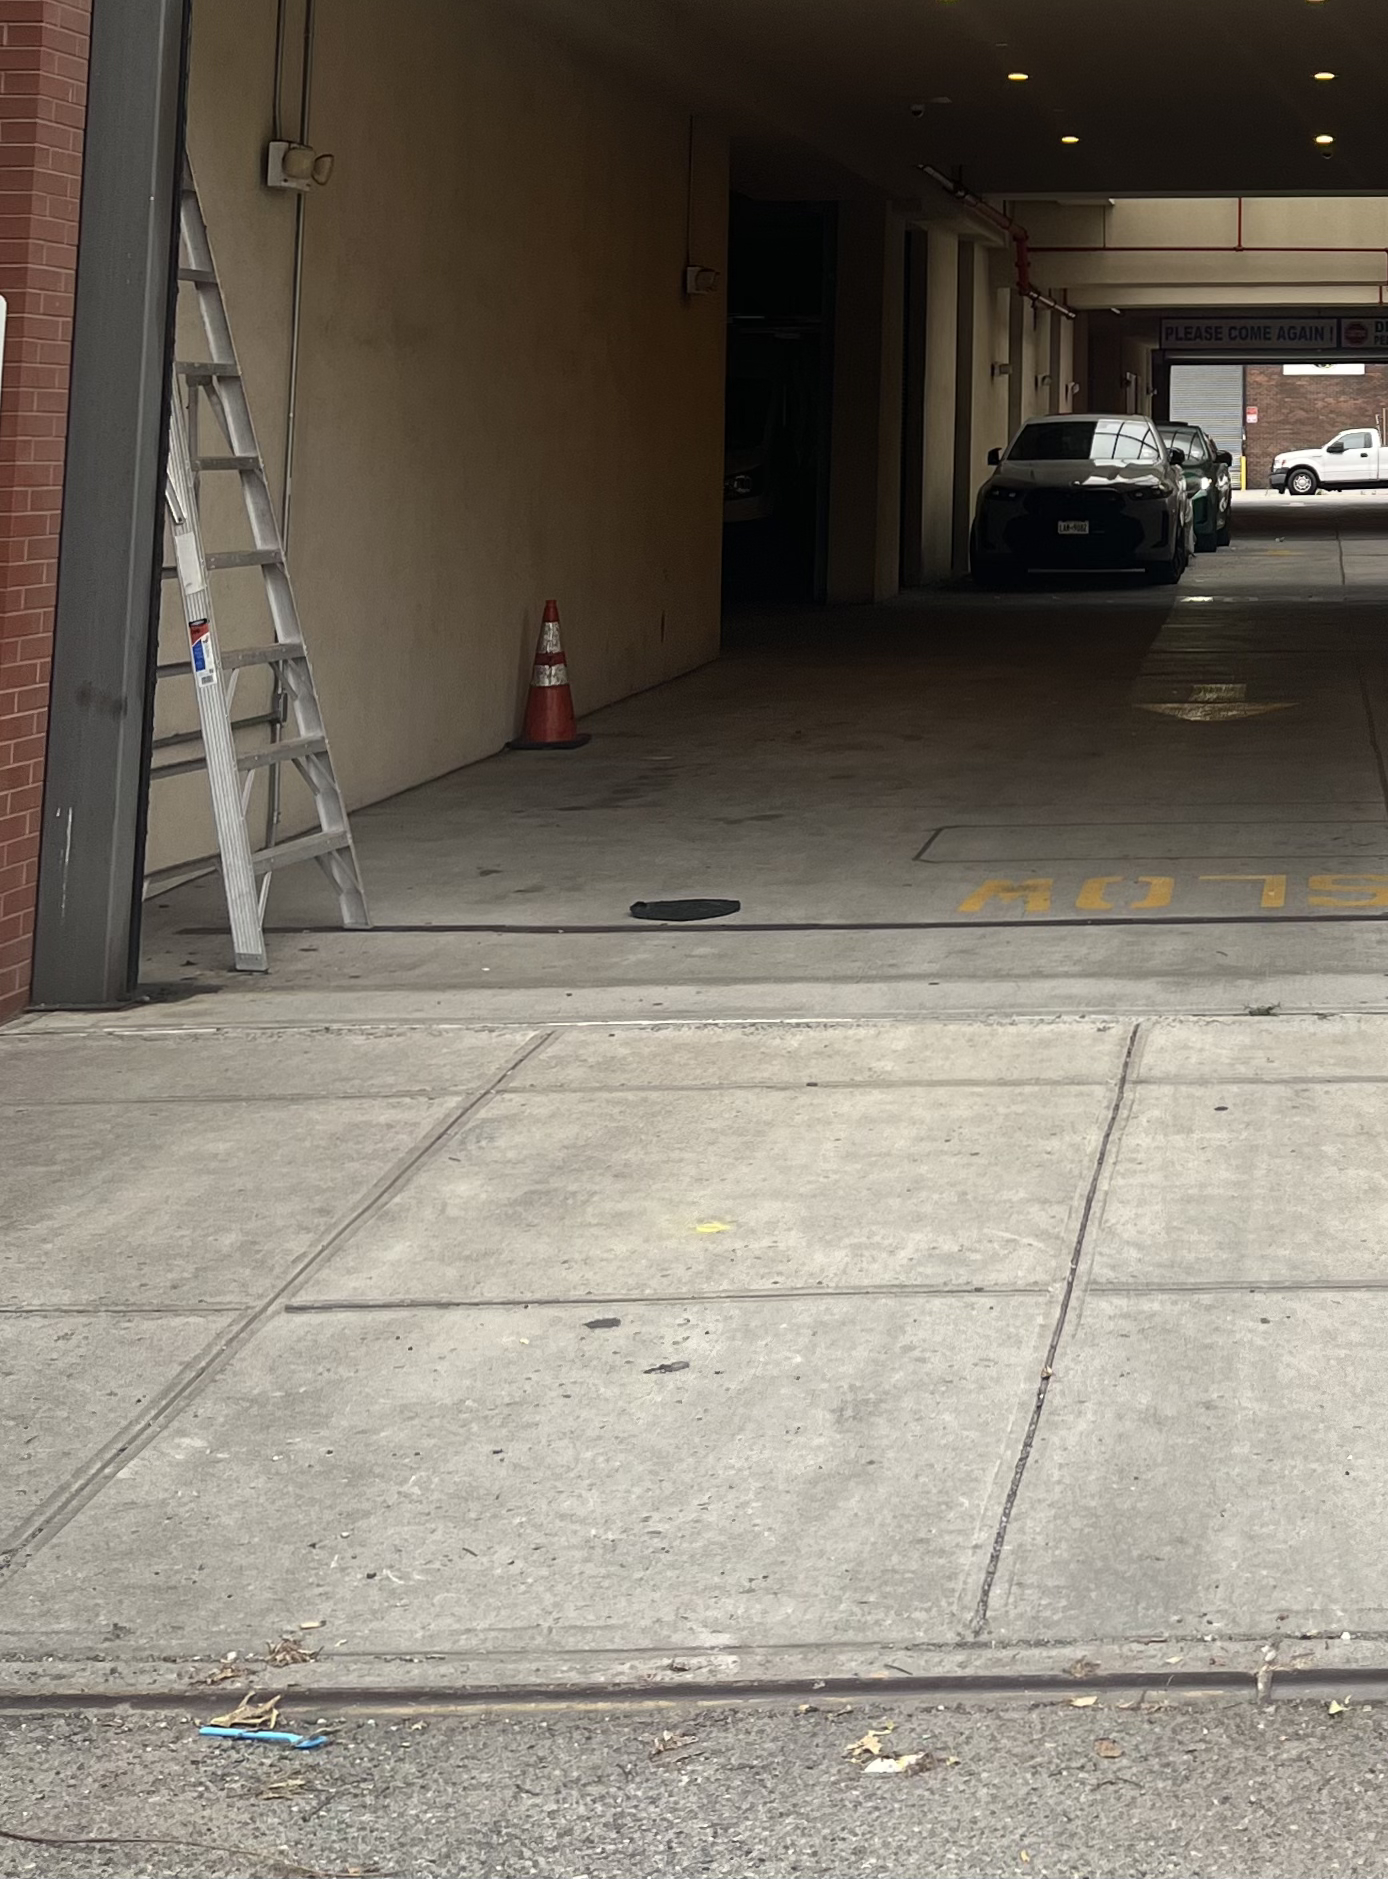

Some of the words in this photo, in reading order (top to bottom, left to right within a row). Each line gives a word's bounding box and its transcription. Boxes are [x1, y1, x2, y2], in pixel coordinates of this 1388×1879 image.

[1164, 325, 1224, 342] PLEASE
[1228, 325, 1272, 342] COME
[1276, 325, 1325, 342] AGAIN
